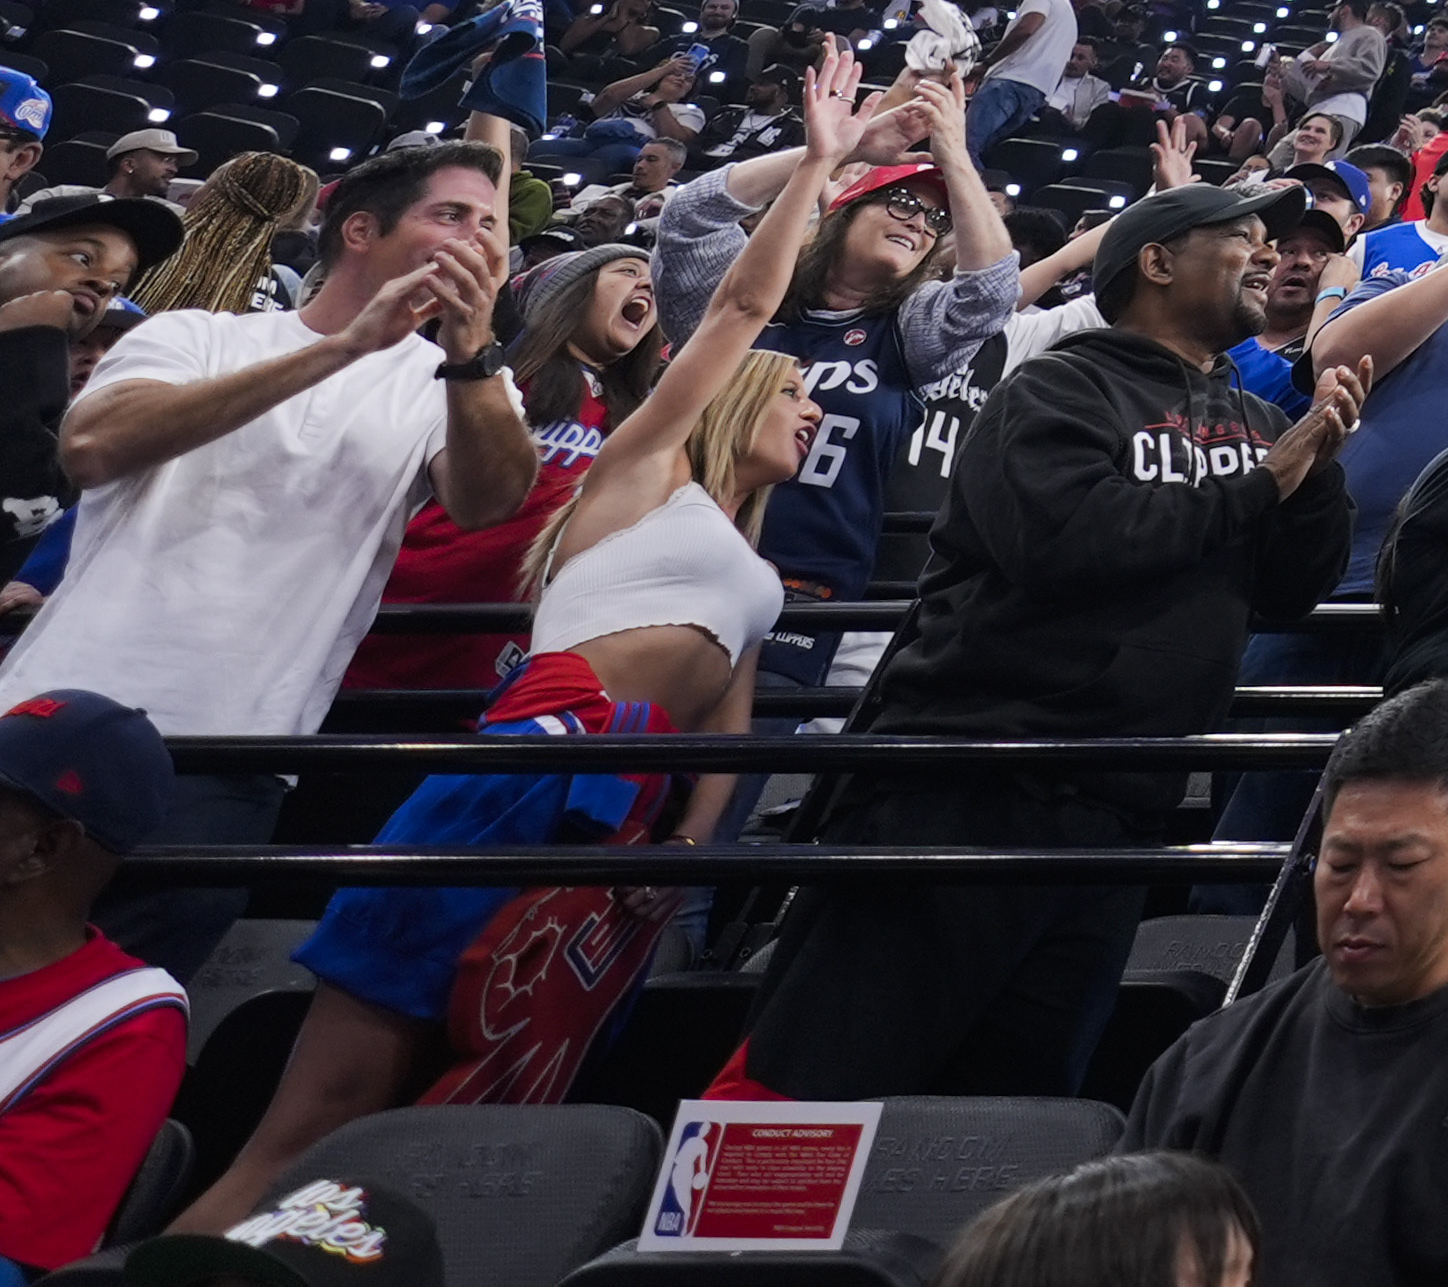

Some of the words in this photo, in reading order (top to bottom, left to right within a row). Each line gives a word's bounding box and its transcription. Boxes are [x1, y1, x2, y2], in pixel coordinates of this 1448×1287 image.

[908, 409, 960, 479] 14
[752, 1128, 792, 1138] CONDUCT
[793, 1128, 835, 1138] ADVISORY
[658, 1211, 683, 1232] NBA
